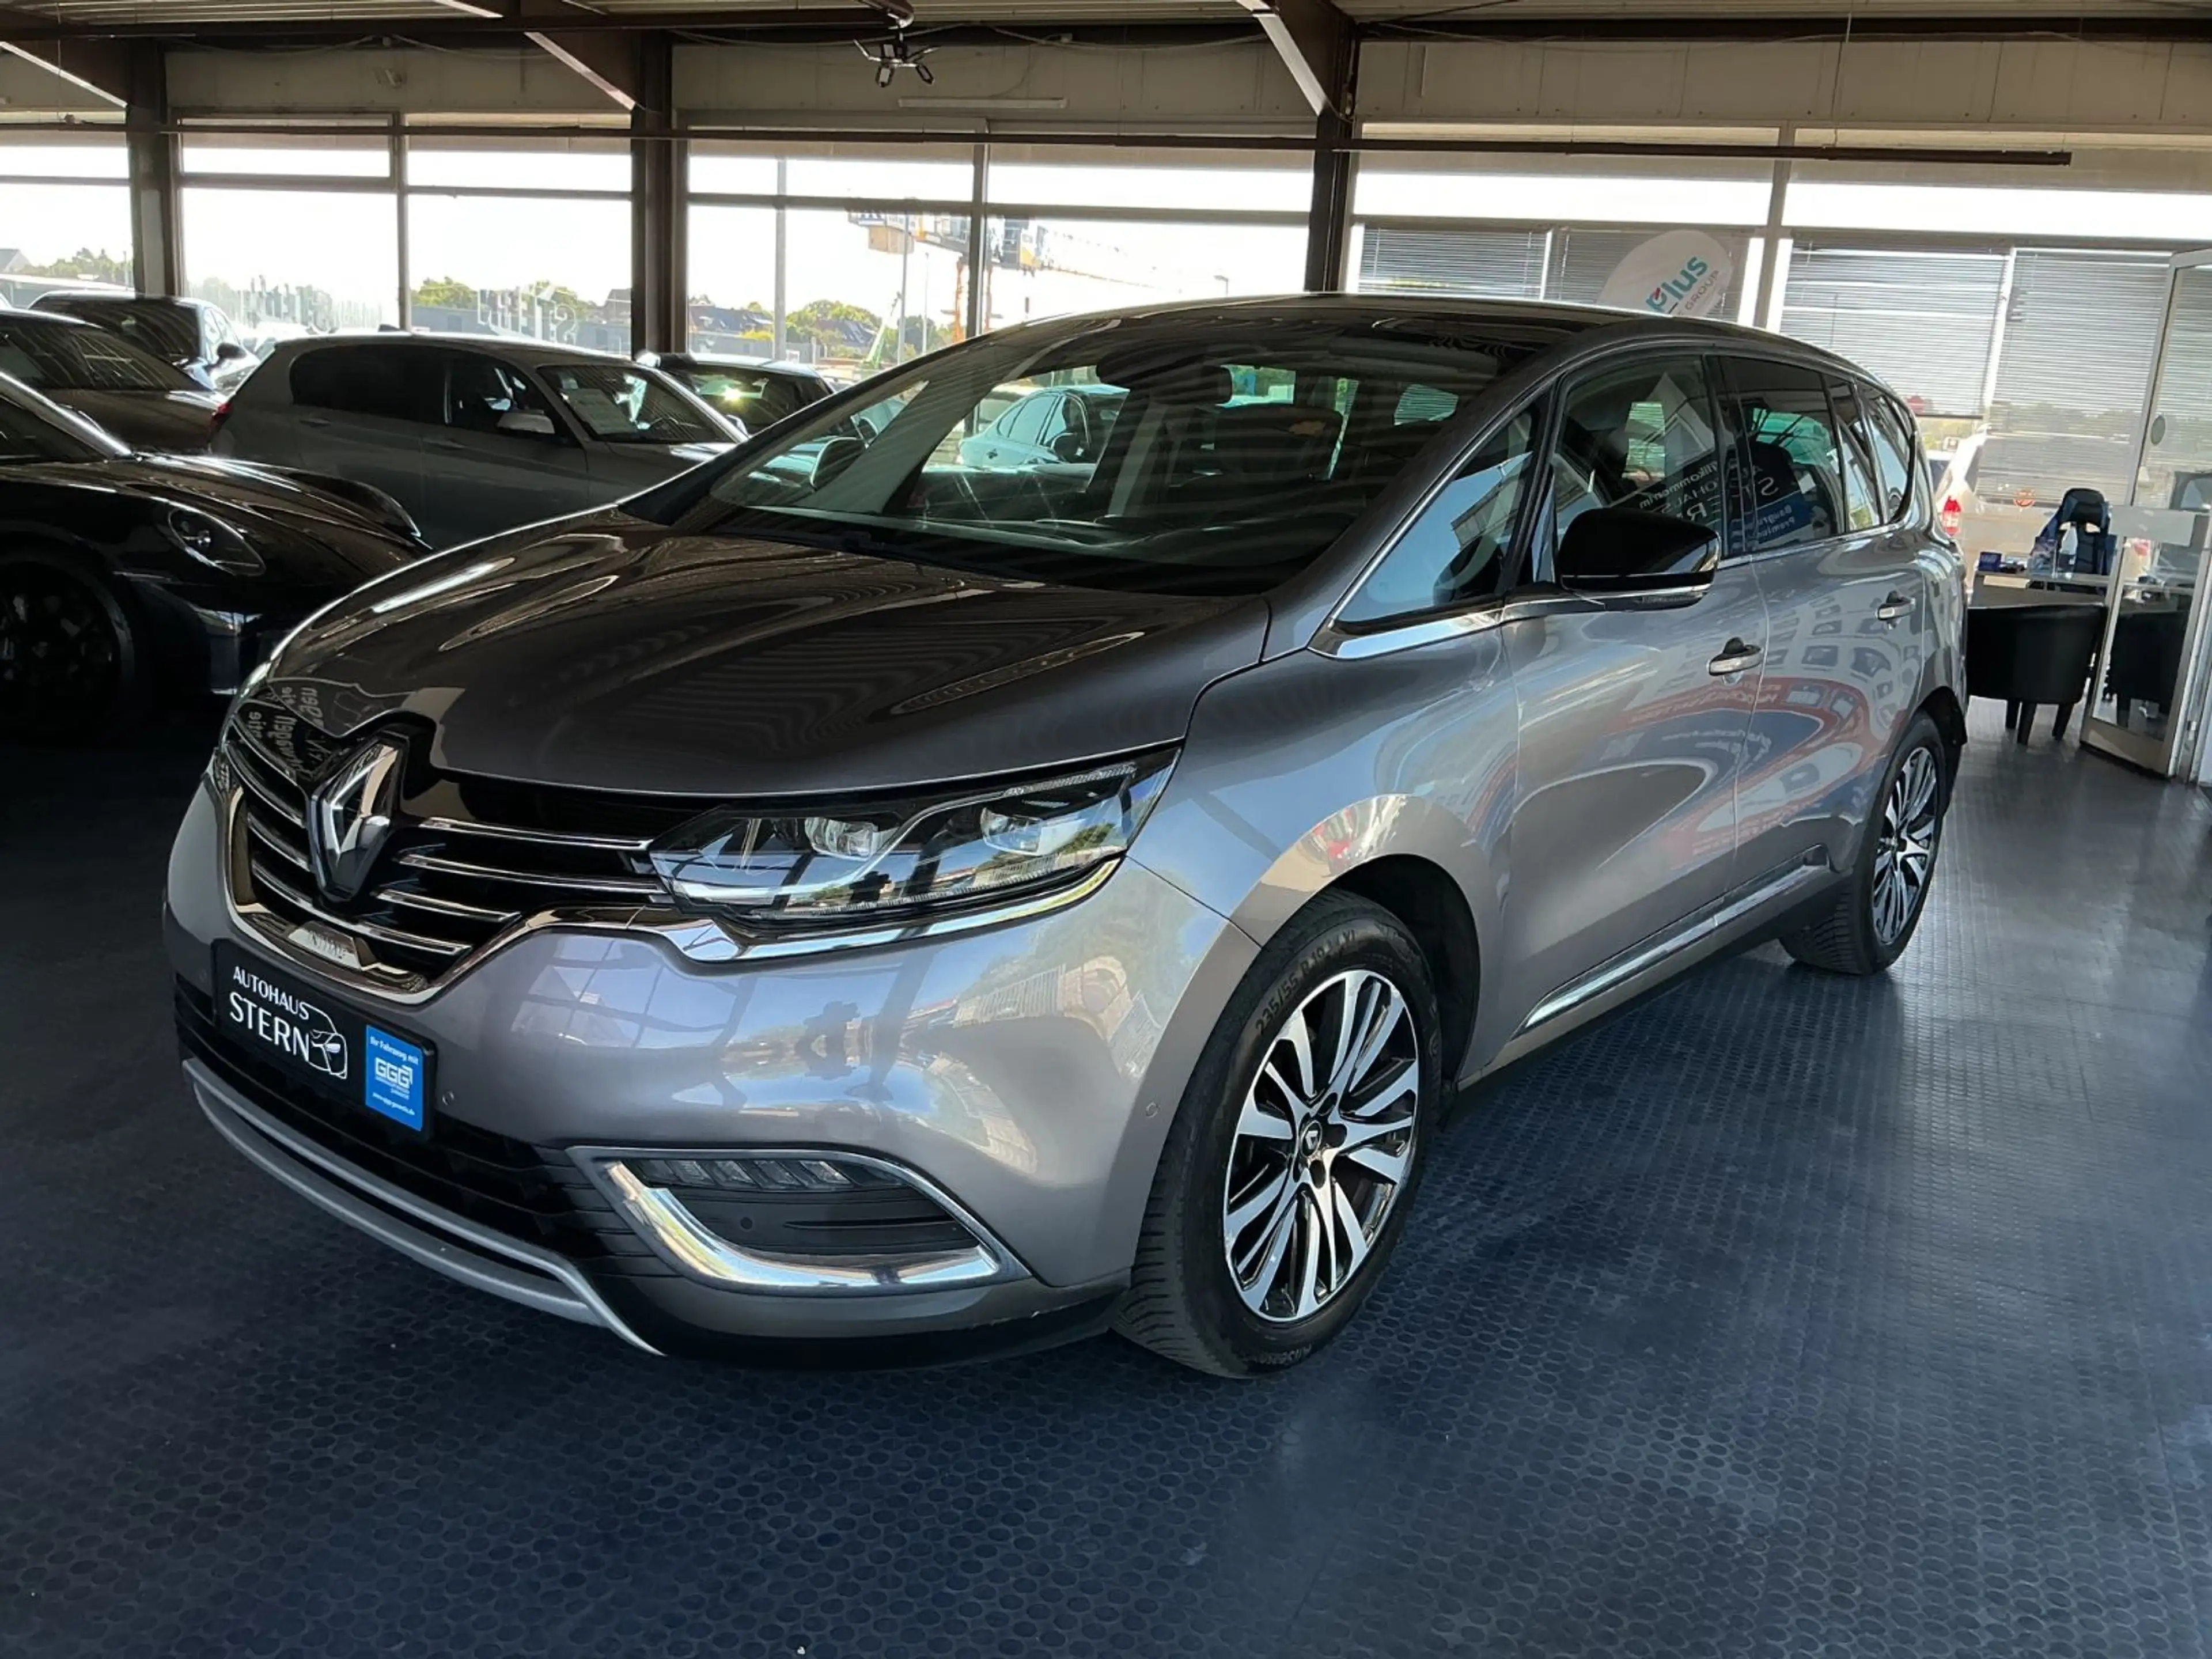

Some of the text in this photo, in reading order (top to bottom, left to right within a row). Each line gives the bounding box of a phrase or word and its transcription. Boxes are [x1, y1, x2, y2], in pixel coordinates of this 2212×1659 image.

[1684, 270, 1719, 310] GROUP
[233, 965, 309, 1020] AUTOHAUS
[1255, 973, 1300, 1033] 235/55
[230, 991, 309, 1062] STERN
[375, 1056, 411, 1089] GGG
